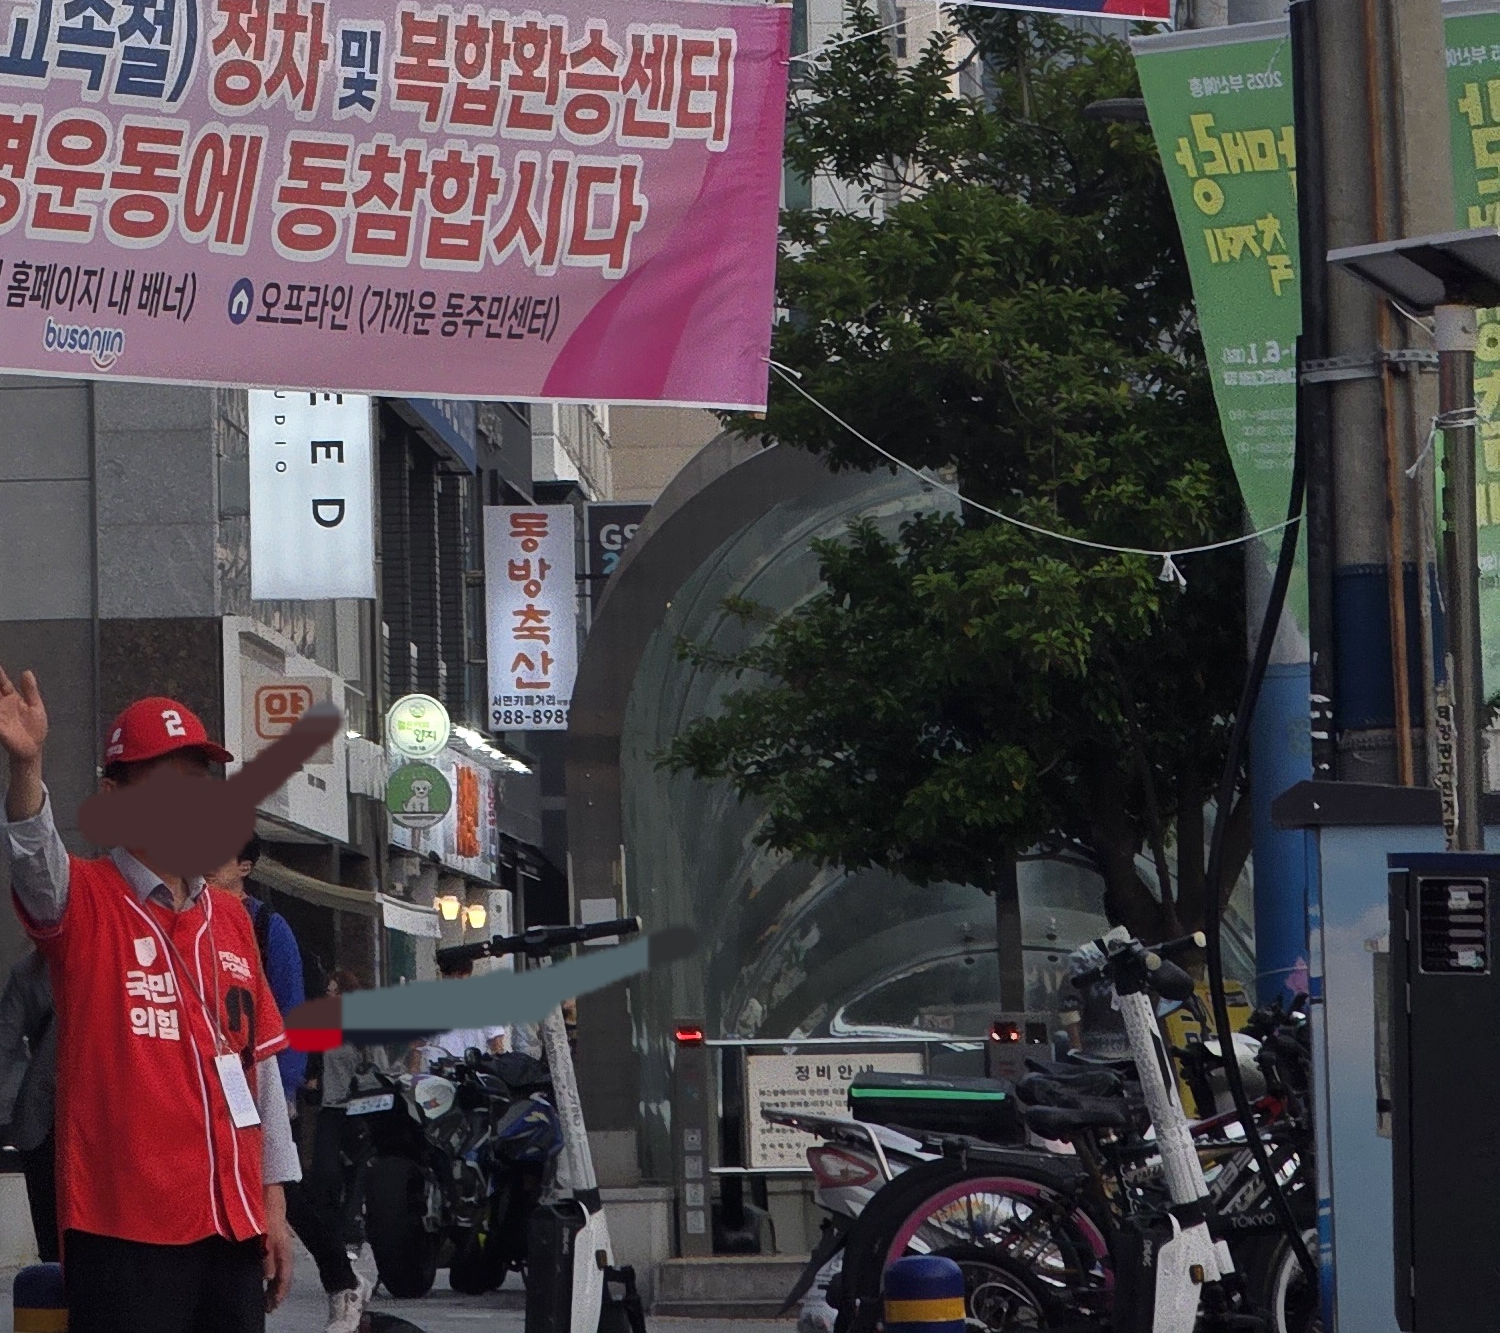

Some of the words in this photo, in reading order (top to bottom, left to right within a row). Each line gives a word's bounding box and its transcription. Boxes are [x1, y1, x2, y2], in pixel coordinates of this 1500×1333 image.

[336, 27, 382, 113] 및
[393, 8, 733, 144] 복합환승센터
[275, 139, 645, 271] 동참합시다
[6, 266, 103, 315] 홈페이지
[107, 268, 137, 316] 내
[137, 271, 198, 325] 배너)
[255, 279, 354, 335] 오프라인
[43, 318, 124, 363] busanjin
[508, 512, 555, 690] 동방축산
[161, 709, 186, 738] 2
[125, 969, 177, 1004] 국민
[129, 1006, 181, 1041] 의힘
